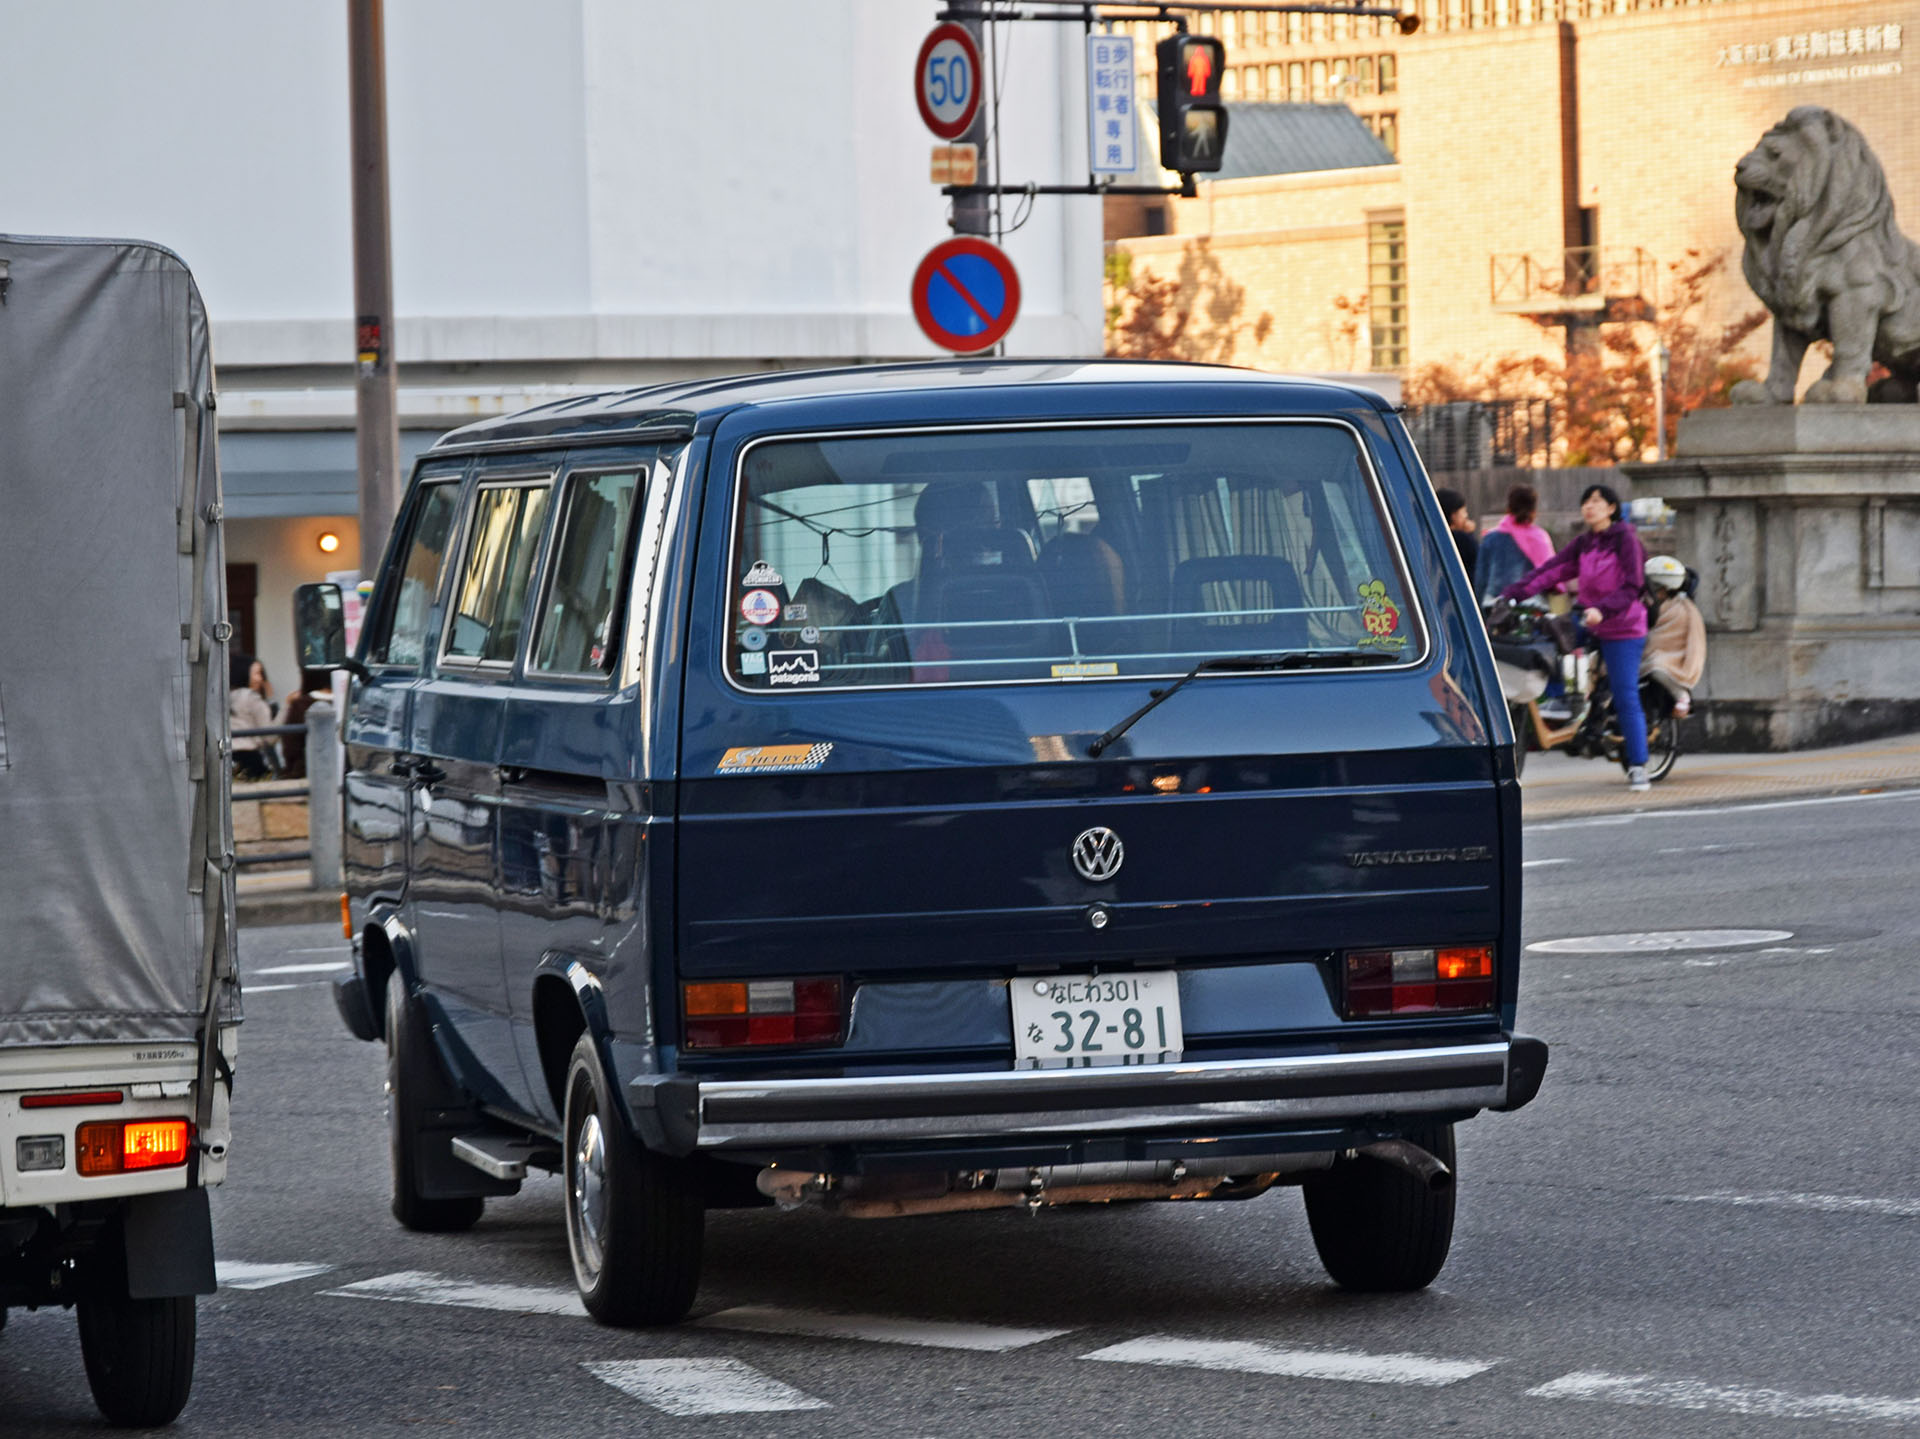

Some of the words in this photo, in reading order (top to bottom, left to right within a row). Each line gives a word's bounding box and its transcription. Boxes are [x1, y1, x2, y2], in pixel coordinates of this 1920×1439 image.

[929, 54, 967, 107] 50
[770, 671, 820, 686] patagonia
[719, 766, 752, 775] RACE
[755, 763, 818, 773] PREPARED
[1027, 1022, 1044, 1043] な
[1051, 1006, 1167, 1053] 32-81
